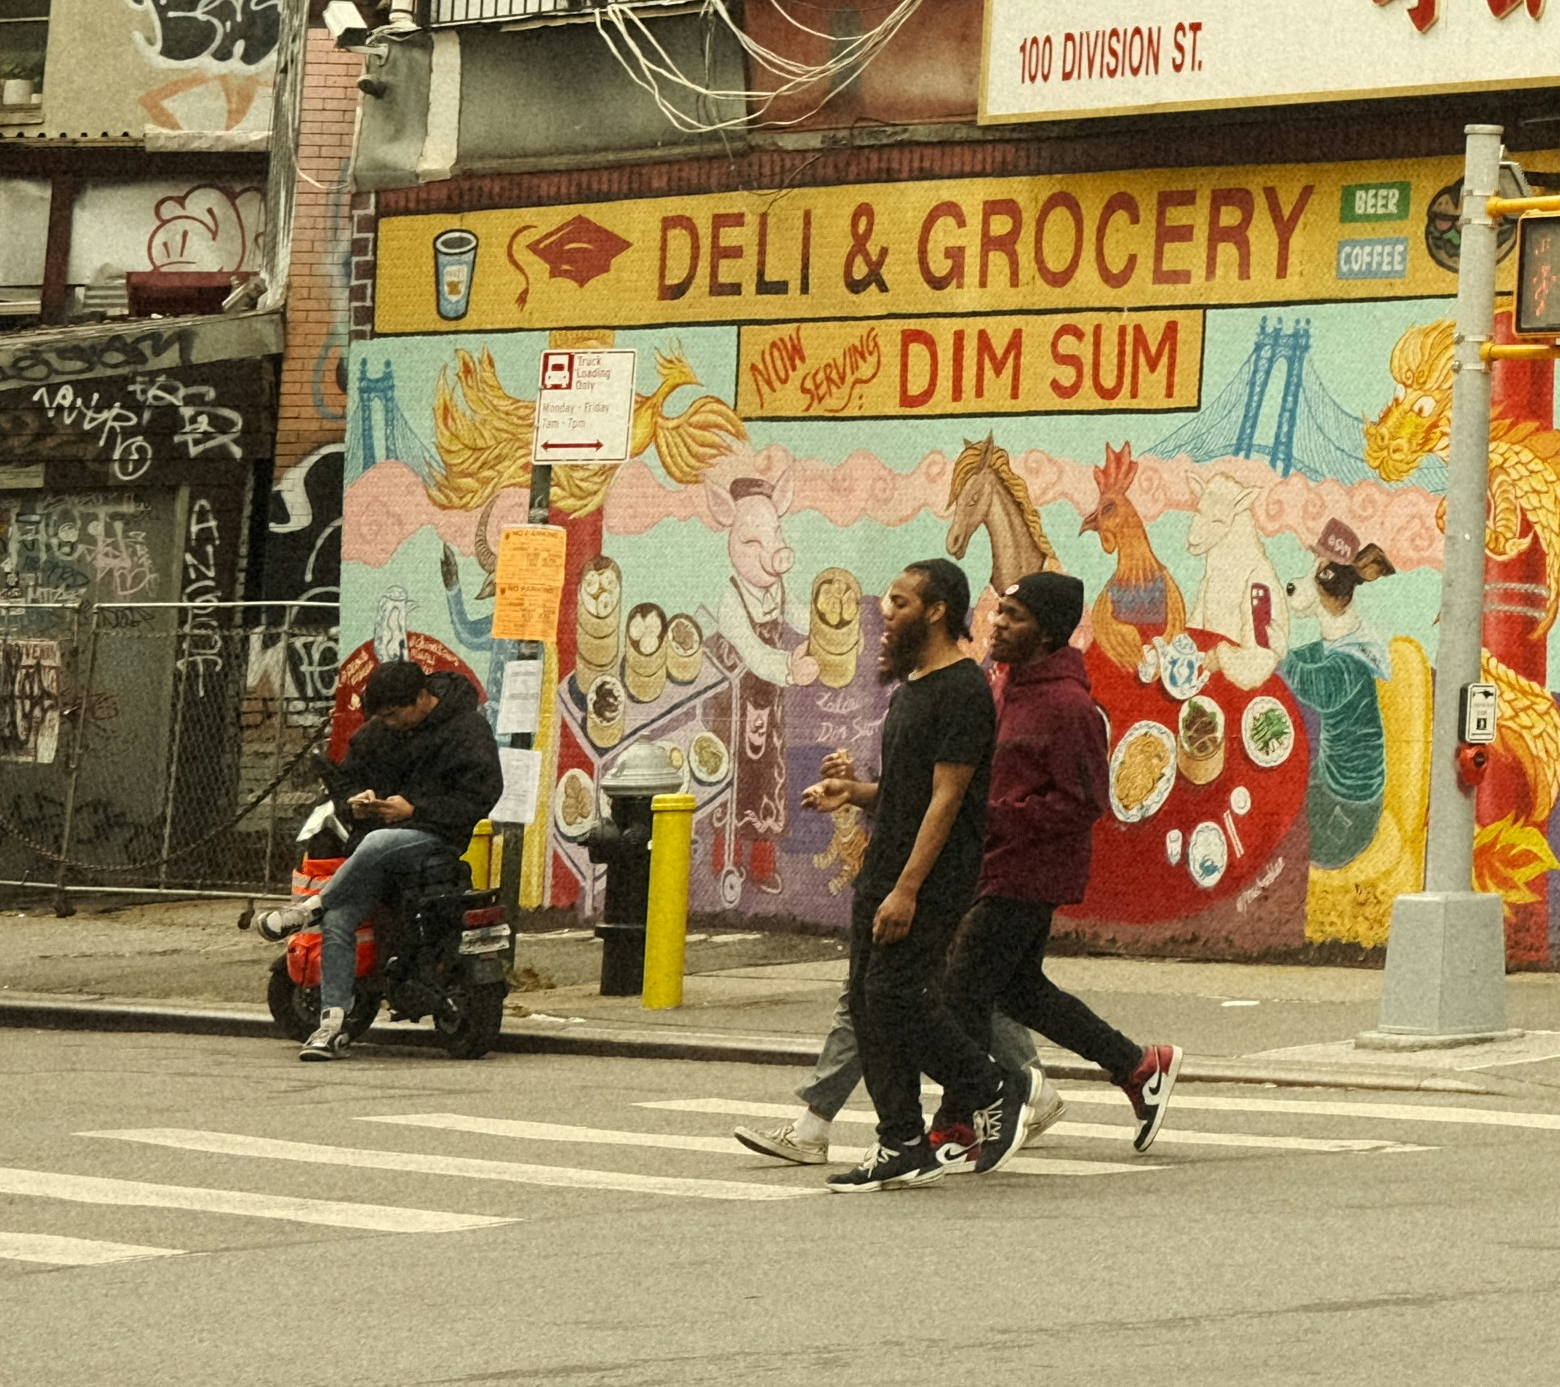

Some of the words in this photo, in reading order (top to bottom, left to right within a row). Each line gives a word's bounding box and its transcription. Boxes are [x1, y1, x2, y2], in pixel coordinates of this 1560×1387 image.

[1019, 34, 1053, 84] 100
[1061, 25, 1162, 81] DIVISION
[1171, 21, 1204, 74] ST.
[1353, 185, 1401, 218] BEER
[657, 207, 811, 302] DELI
[843, 203, 890, 295] &
[916, 183, 1318, 294] GROCERY
[1338, 242, 1407, 276] COFFEE
[575, 355, 602, 367] Truck
[575, 367, 612, 380] Loading
[746, 317, 815, 409] NOW
[796, 325, 884, 415] SERVING
[898, 326, 1025, 409] DIM
[1050, 319, 1179, 402] SUM
